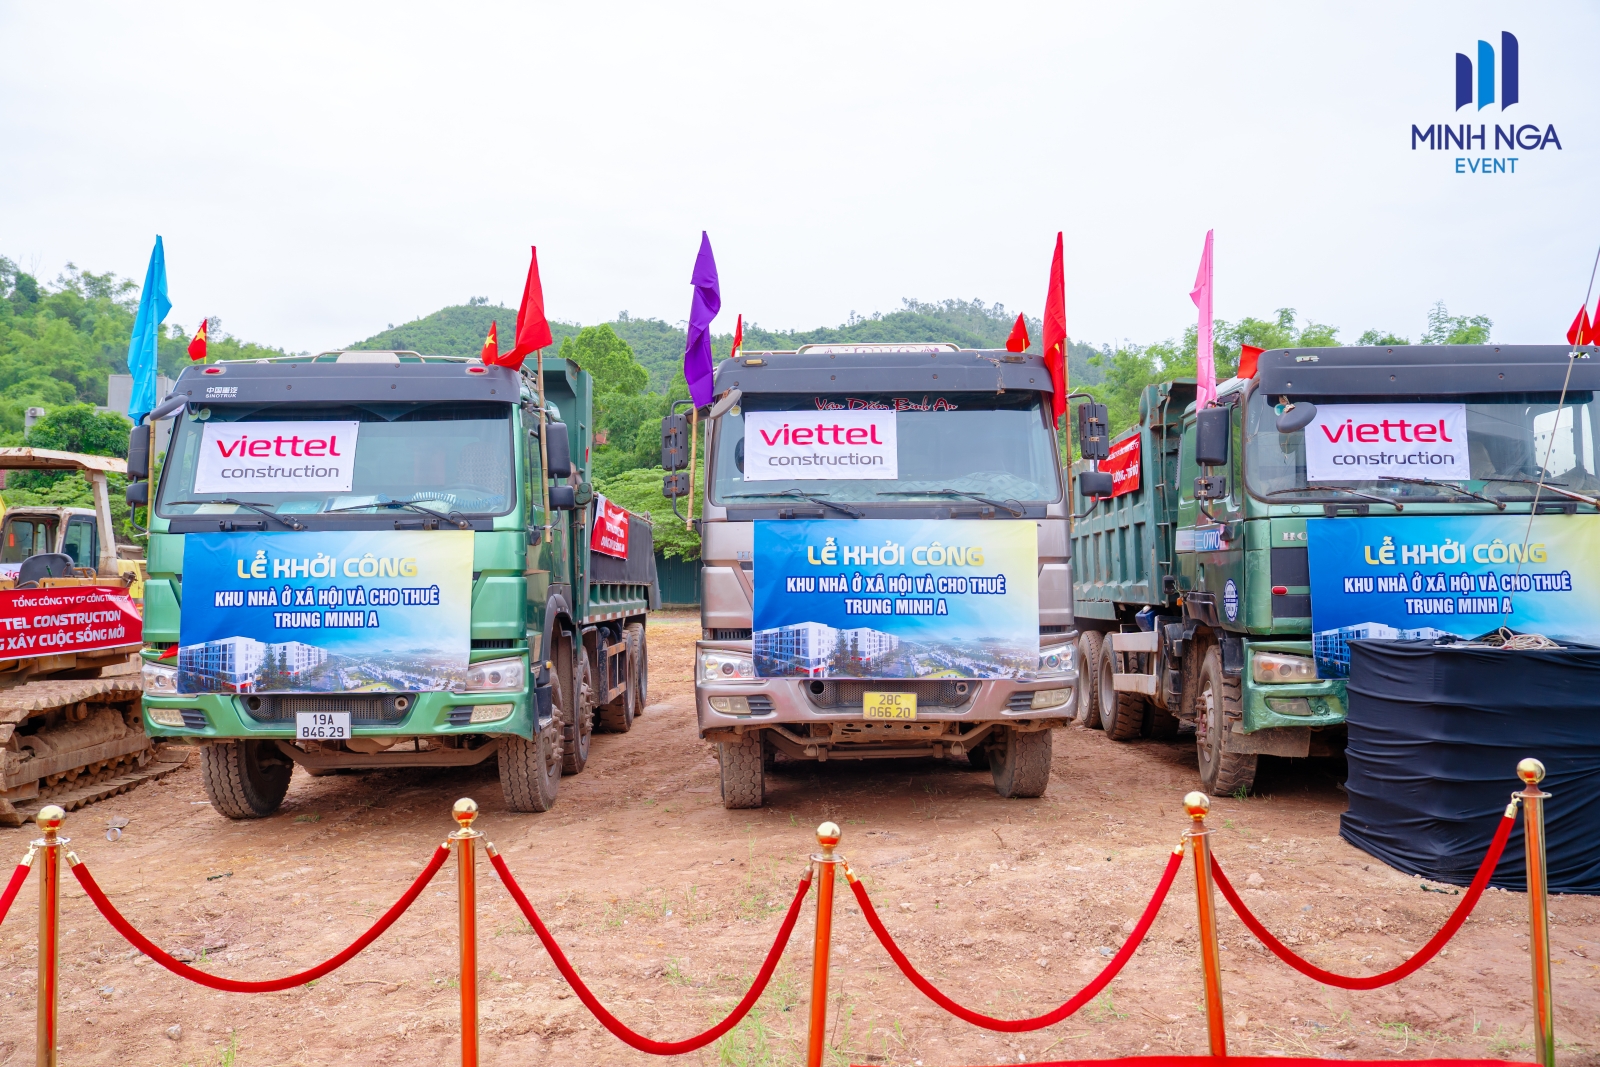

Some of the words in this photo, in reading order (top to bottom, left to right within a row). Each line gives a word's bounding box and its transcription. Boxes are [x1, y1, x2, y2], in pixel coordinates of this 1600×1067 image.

[933, 397, 958, 411] An
[759, 424, 883, 446] viettel
[1320, 419, 1453, 443] viettel
[216, 435, 341, 457] viettel
[768, 453, 884, 466] construction
[1333, 452, 1455, 465] construction
[221, 465, 339, 478] construction
[807, 537, 837, 566] LỄ
[843, 540, 905, 566] KHỞI
[911, 542, 985, 566] CÔNG
[1364, 536, 1396, 565] LỄ
[1402, 538, 1466, 565] KHỞI
[1473, 538, 1548, 564] CÔNG
[237, 550, 267, 579] LỄ
[273, 553, 337, 578] KHỞI
[343, 553, 418, 577] CÔNG
[786, 577, 815, 593] KHU
[818, 574, 848, 593] NHÀ
[851, 572, 862, 593] Ở
[865, 574, 885, 592] XÃ
[888, 575, 912, 596] HỘI
[916, 574, 934, 593] VÀ
[937, 577, 967, 594] CHO
[970, 574, 1006, 594] THUÊ
[1344, 577, 1374, 593] KHU
[1378, 574, 1408, 592] NHÀ
[1411, 571, 1422, 592] Ở
[1426, 573, 1446, 592] XÃ
[1450, 573, 1475, 595] HỘI
[1479, 572, 1498, 591] VÀ
[1501, 574, 1530, 591] CHO
[1534, 571, 1572, 591] THUÊ
[12, 595, 37, 608] TỔNG
[38, 595, 62, 606] CÔNG
[63, 596, 75, 604] TY
[76, 595, 86, 603] CP
[86, 593, 105, 603] CÔNG
[215, 590, 244, 606] KHU
[248, 587, 277, 606] NHÀ
[281, 585, 292, 606] Ở
[295, 587, 315, 606] XÃ
[318, 587, 343, 608] HỘI
[346, 587, 366, 605] VÀ
[369, 588, 399, 605] CHO
[402, 585, 439, 605] THUÊ
[845, 599, 892, 615] TRUNG
[895, 599, 933, 615] MINH
[936, 599, 948, 615] A
[1405, 598, 1454, 614] TRUNG
[1458, 597, 1498, 614] MINH
[1501, 597, 1513, 613] A
[34, 610, 121, 628] CONSTRUCTION
[274, 612, 320, 627] TRUNG
[324, 611, 364, 627] MINH
[367, 611, 379, 627] A
[7, 633, 36, 650] XÂY
[38, 629, 74, 647] CUỘC
[76, 624, 107, 643] SỐNG
[108, 624, 125, 639] MỚI
[879, 694, 901, 705] 28C
[313, 714, 334, 725] 19A
[870, 707, 911, 718] 066.20
[302, 727, 345, 738] 846.29
